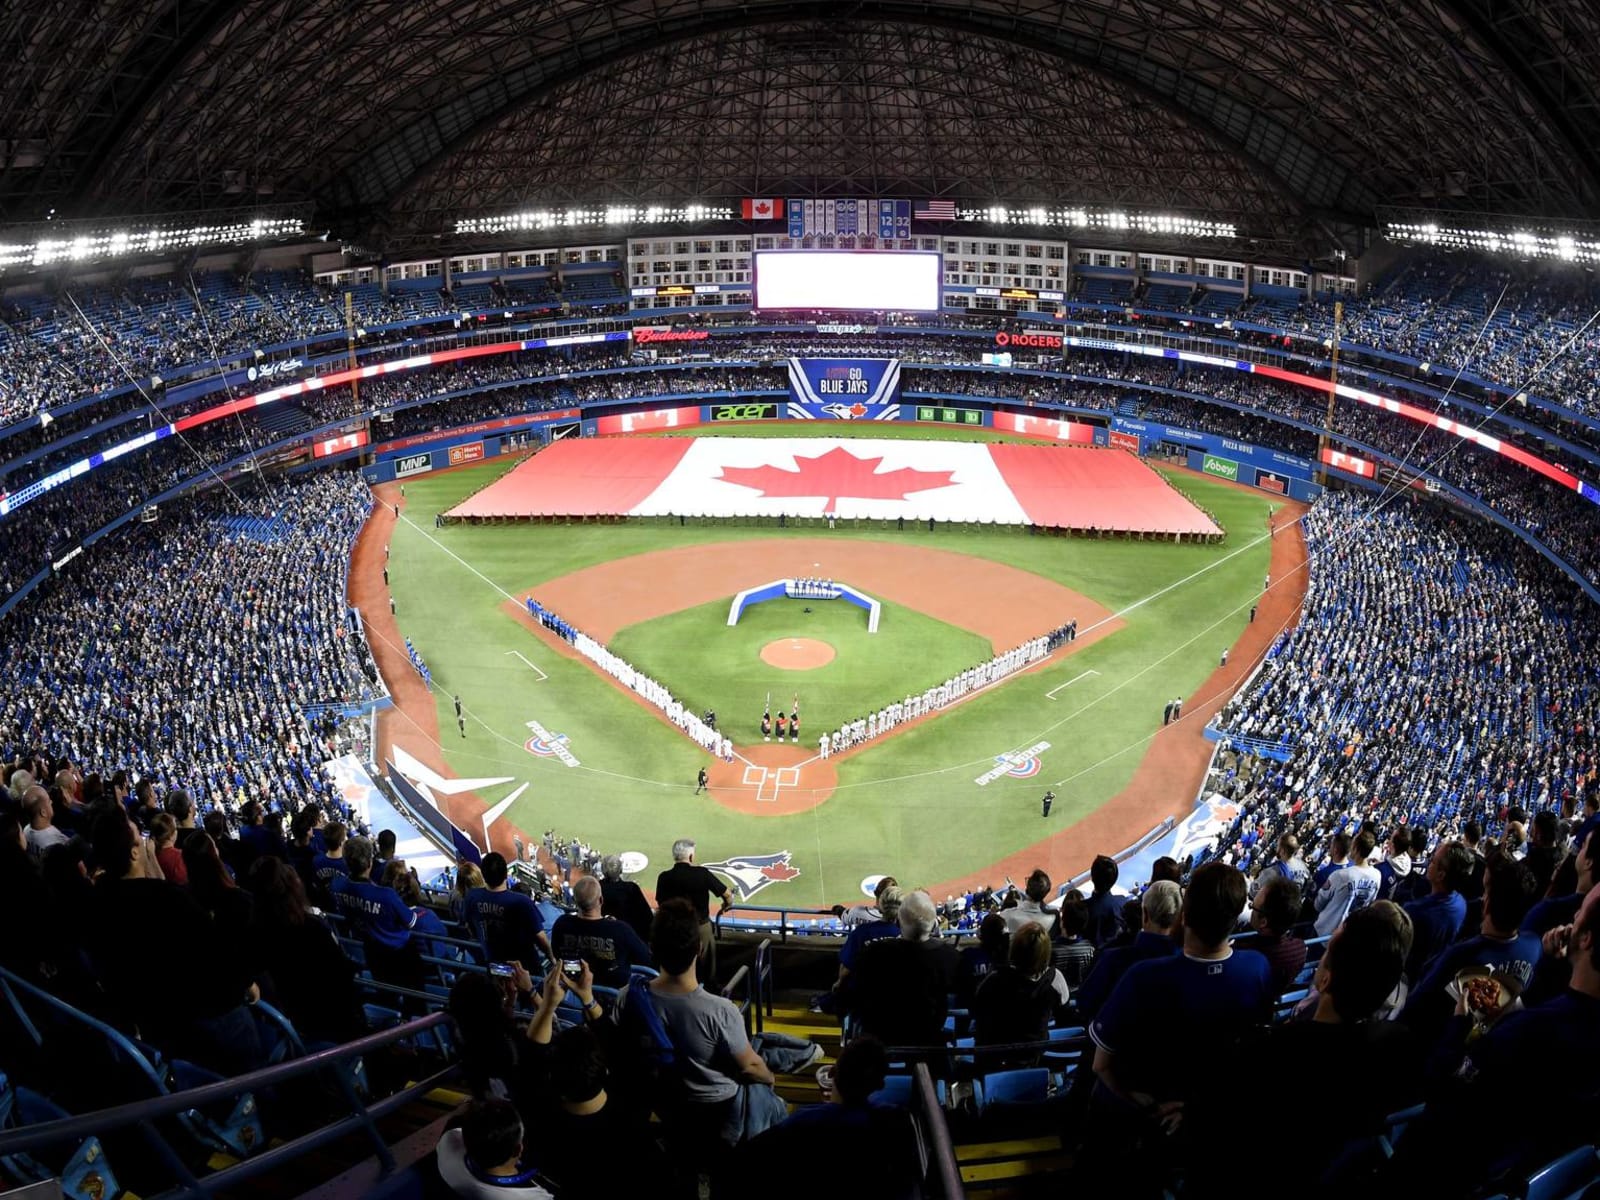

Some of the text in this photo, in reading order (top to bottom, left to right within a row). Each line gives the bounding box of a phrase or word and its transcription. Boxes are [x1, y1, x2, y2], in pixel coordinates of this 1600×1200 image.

[881, 216, 892, 226] 12
[896, 217, 909, 226] 32
[634, 329, 708, 342] Budweiser
[816, 325, 851, 335] WESTJET
[1012, 334, 1061, 347] ROGERS
[849, 367, 862, 380] GO
[821, 380, 868, 394] BLUE JAYS
[717, 404, 772, 420] acer
[1222, 439, 1238, 451] PIZZA
[400, 456, 426, 472] MNP
